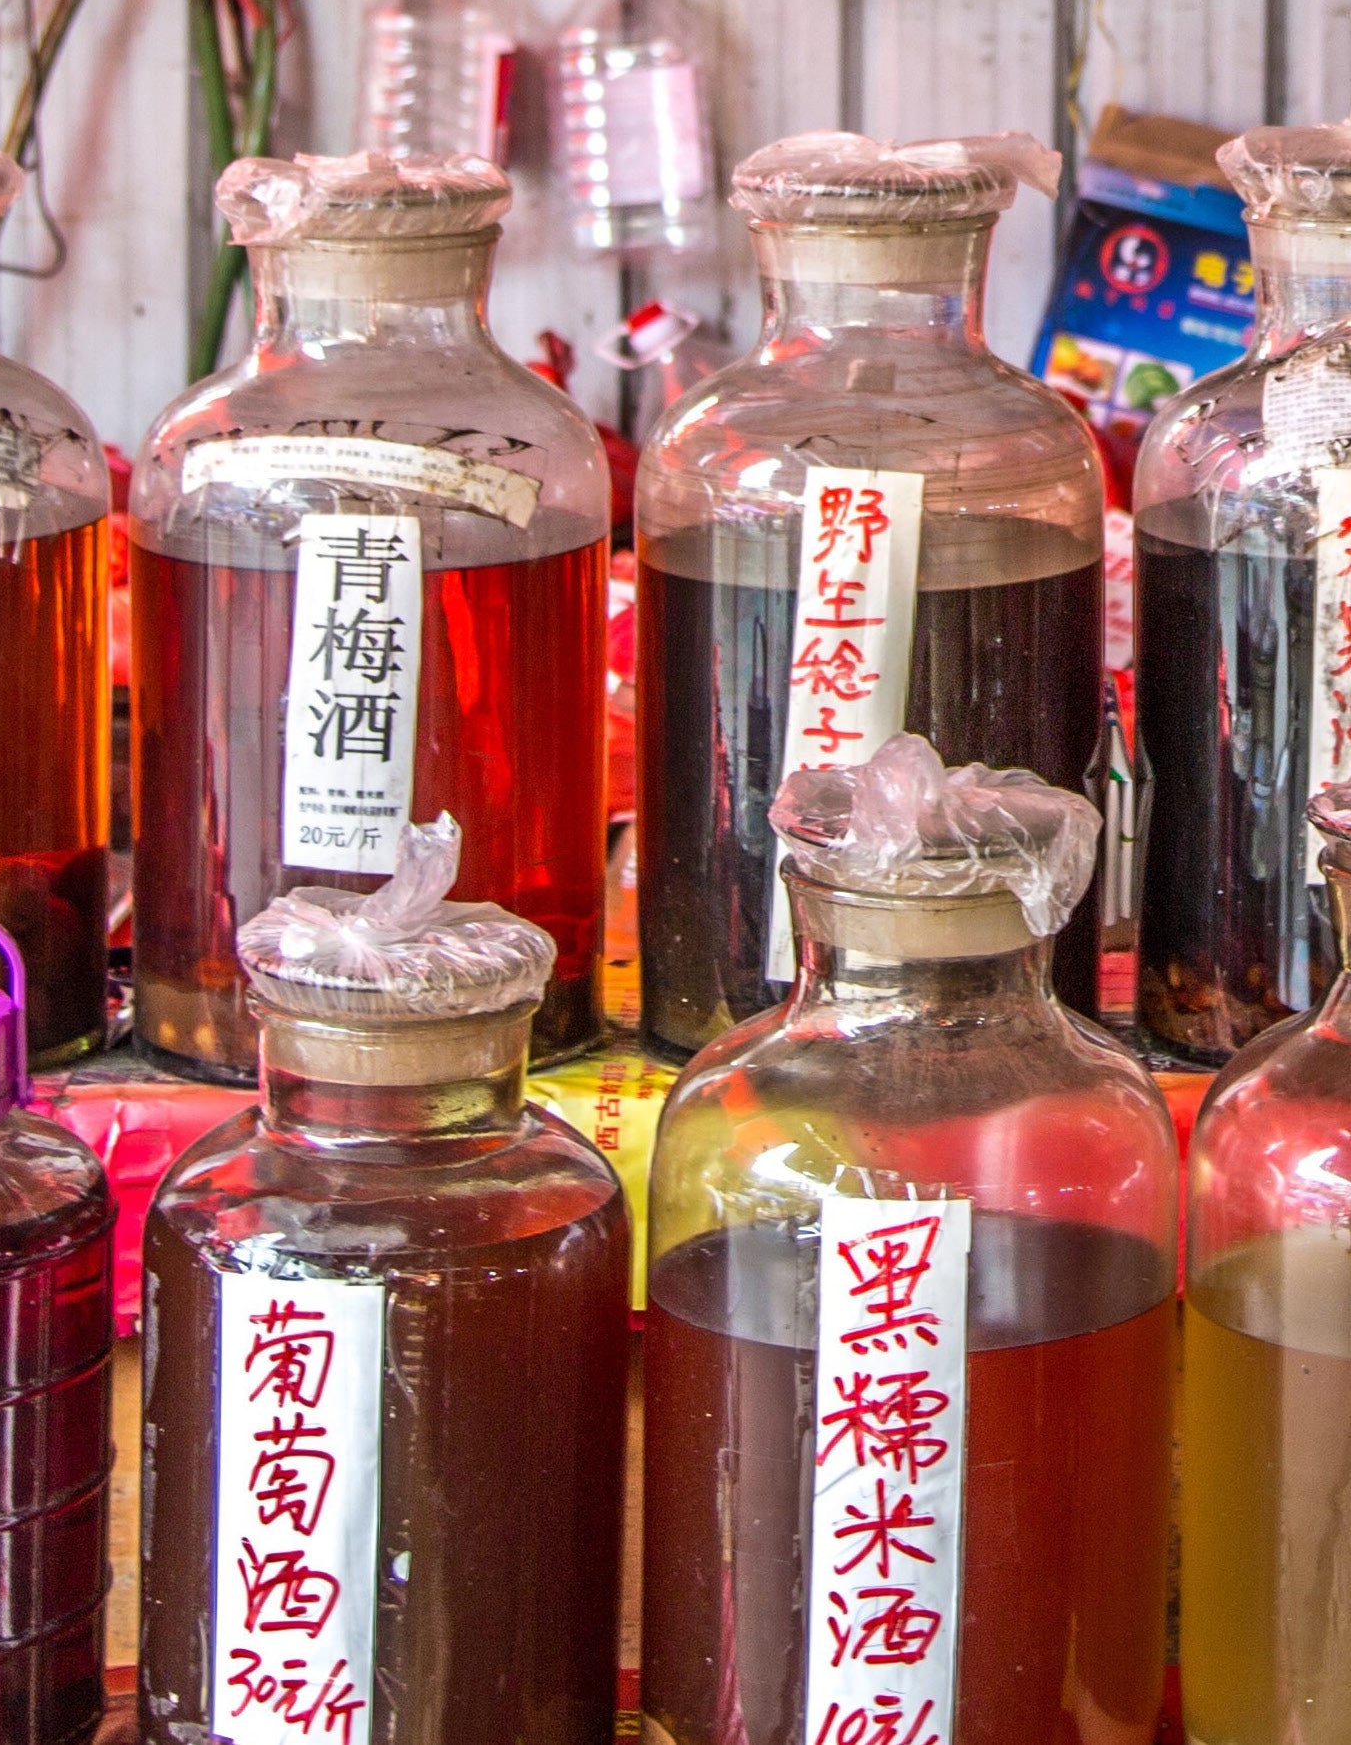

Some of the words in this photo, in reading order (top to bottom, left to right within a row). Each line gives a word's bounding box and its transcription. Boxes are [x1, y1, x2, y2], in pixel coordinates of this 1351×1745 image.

[307, 527, 410, 763] 青梅酒
[298, 824, 384, 851] 20元/斤
[237, 1298, 341, 1639] 葡萄酒
[815, 1215, 950, 1668] 黑糯米酒
